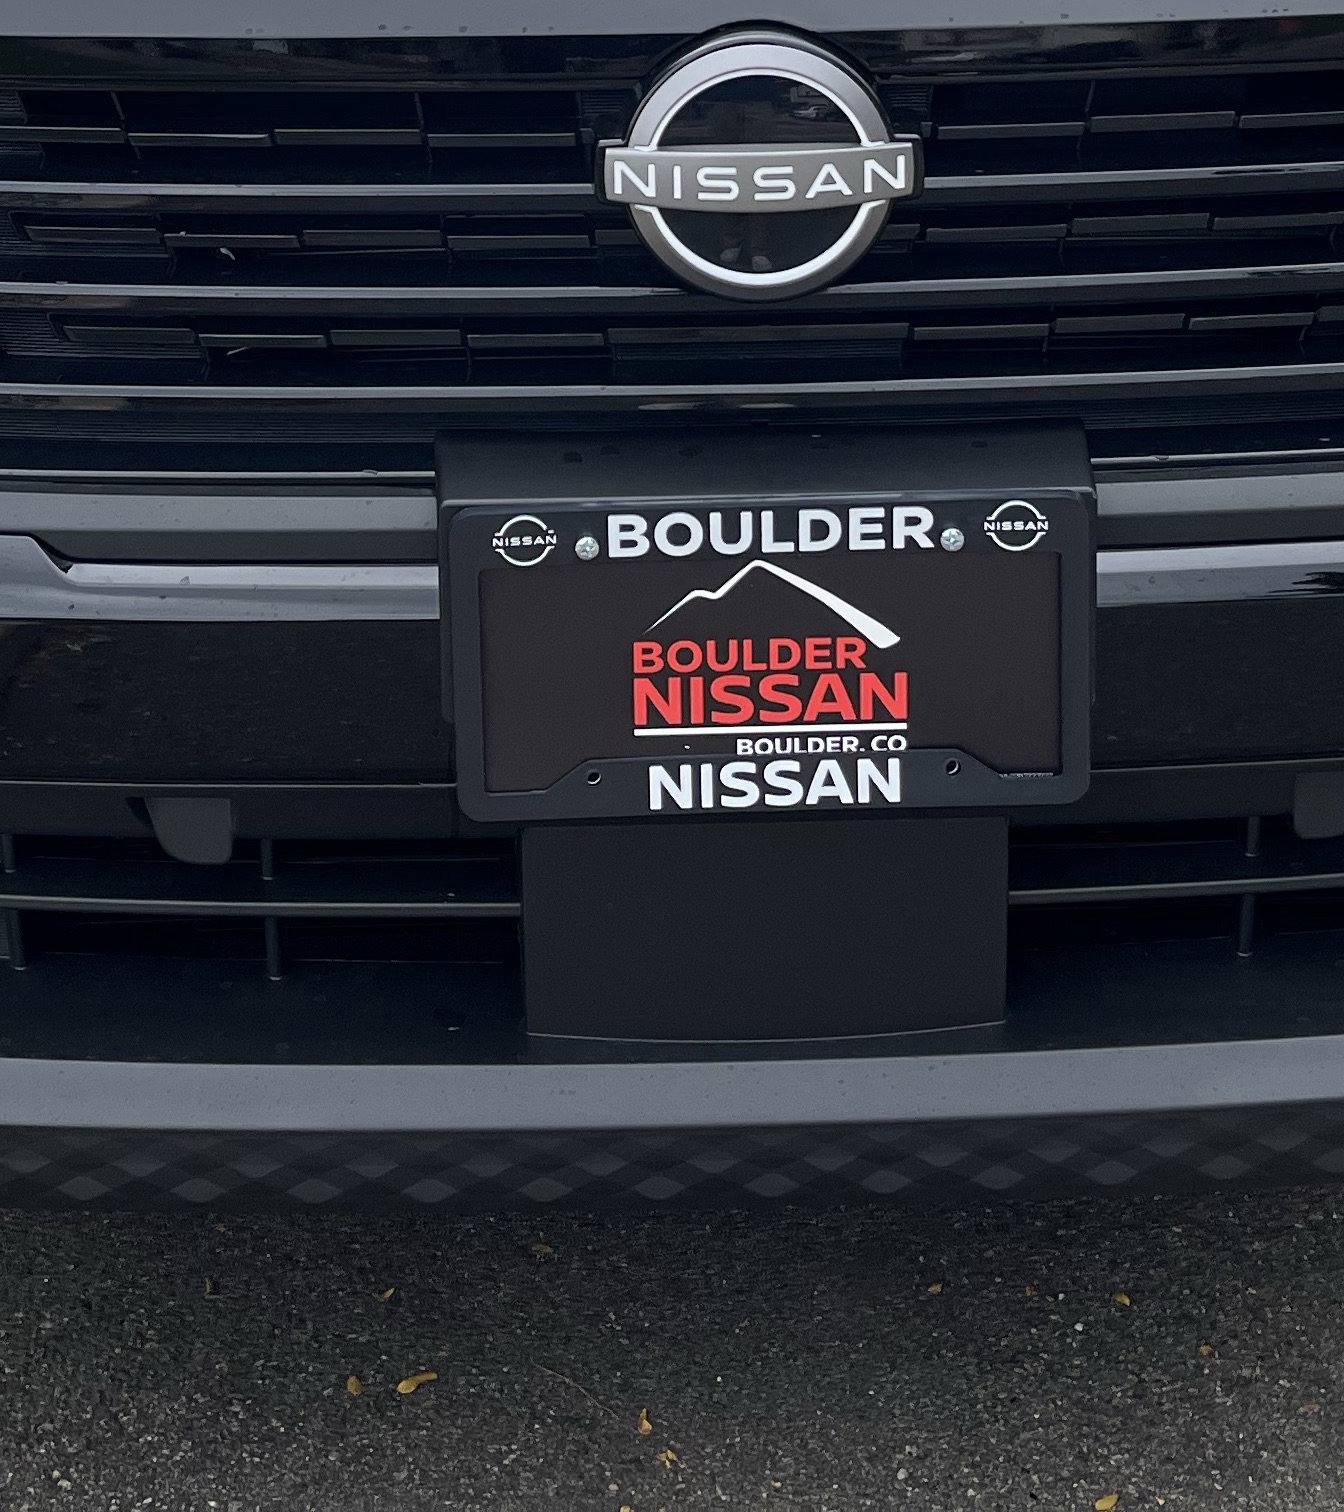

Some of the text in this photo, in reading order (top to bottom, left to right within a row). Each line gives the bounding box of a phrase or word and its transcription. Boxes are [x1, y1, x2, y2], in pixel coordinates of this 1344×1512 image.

[612, 154, 906, 201] NISSAN
[491, 535, 557, 548] NISSAN
[607, 506, 935, 558] BOULDER
[983, 520, 1049, 532] NISSAN
[632, 637, 867, 674] BOULDER
[632, 671, 908, 726] NISSAN
[870, 734, 907, 752] CO
[648, 757, 902, 811] NISSAN
